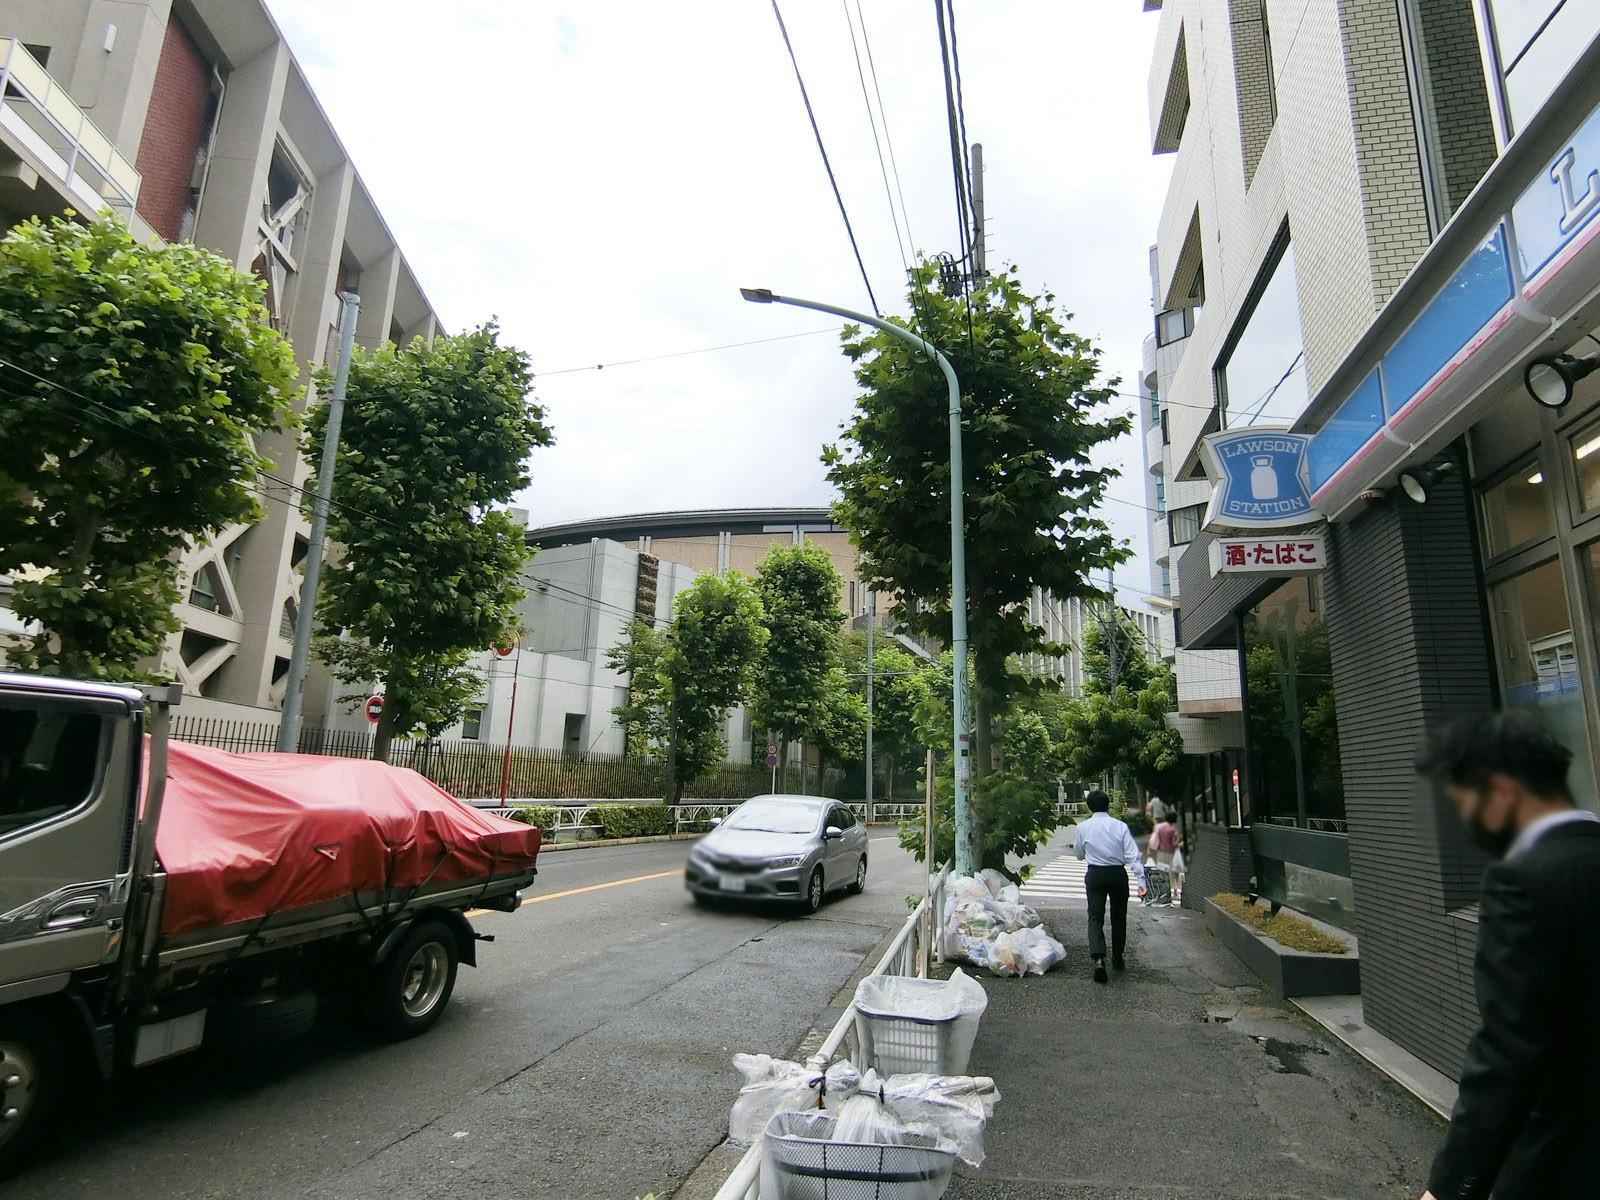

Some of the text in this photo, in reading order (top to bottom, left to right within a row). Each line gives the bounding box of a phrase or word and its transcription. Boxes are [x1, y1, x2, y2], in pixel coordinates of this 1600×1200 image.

[1223, 440, 1300, 458] LAWSON
[1229, 496, 1305, 514] STATION
[1225, 543, 1317, 566] 酒・たばこ
